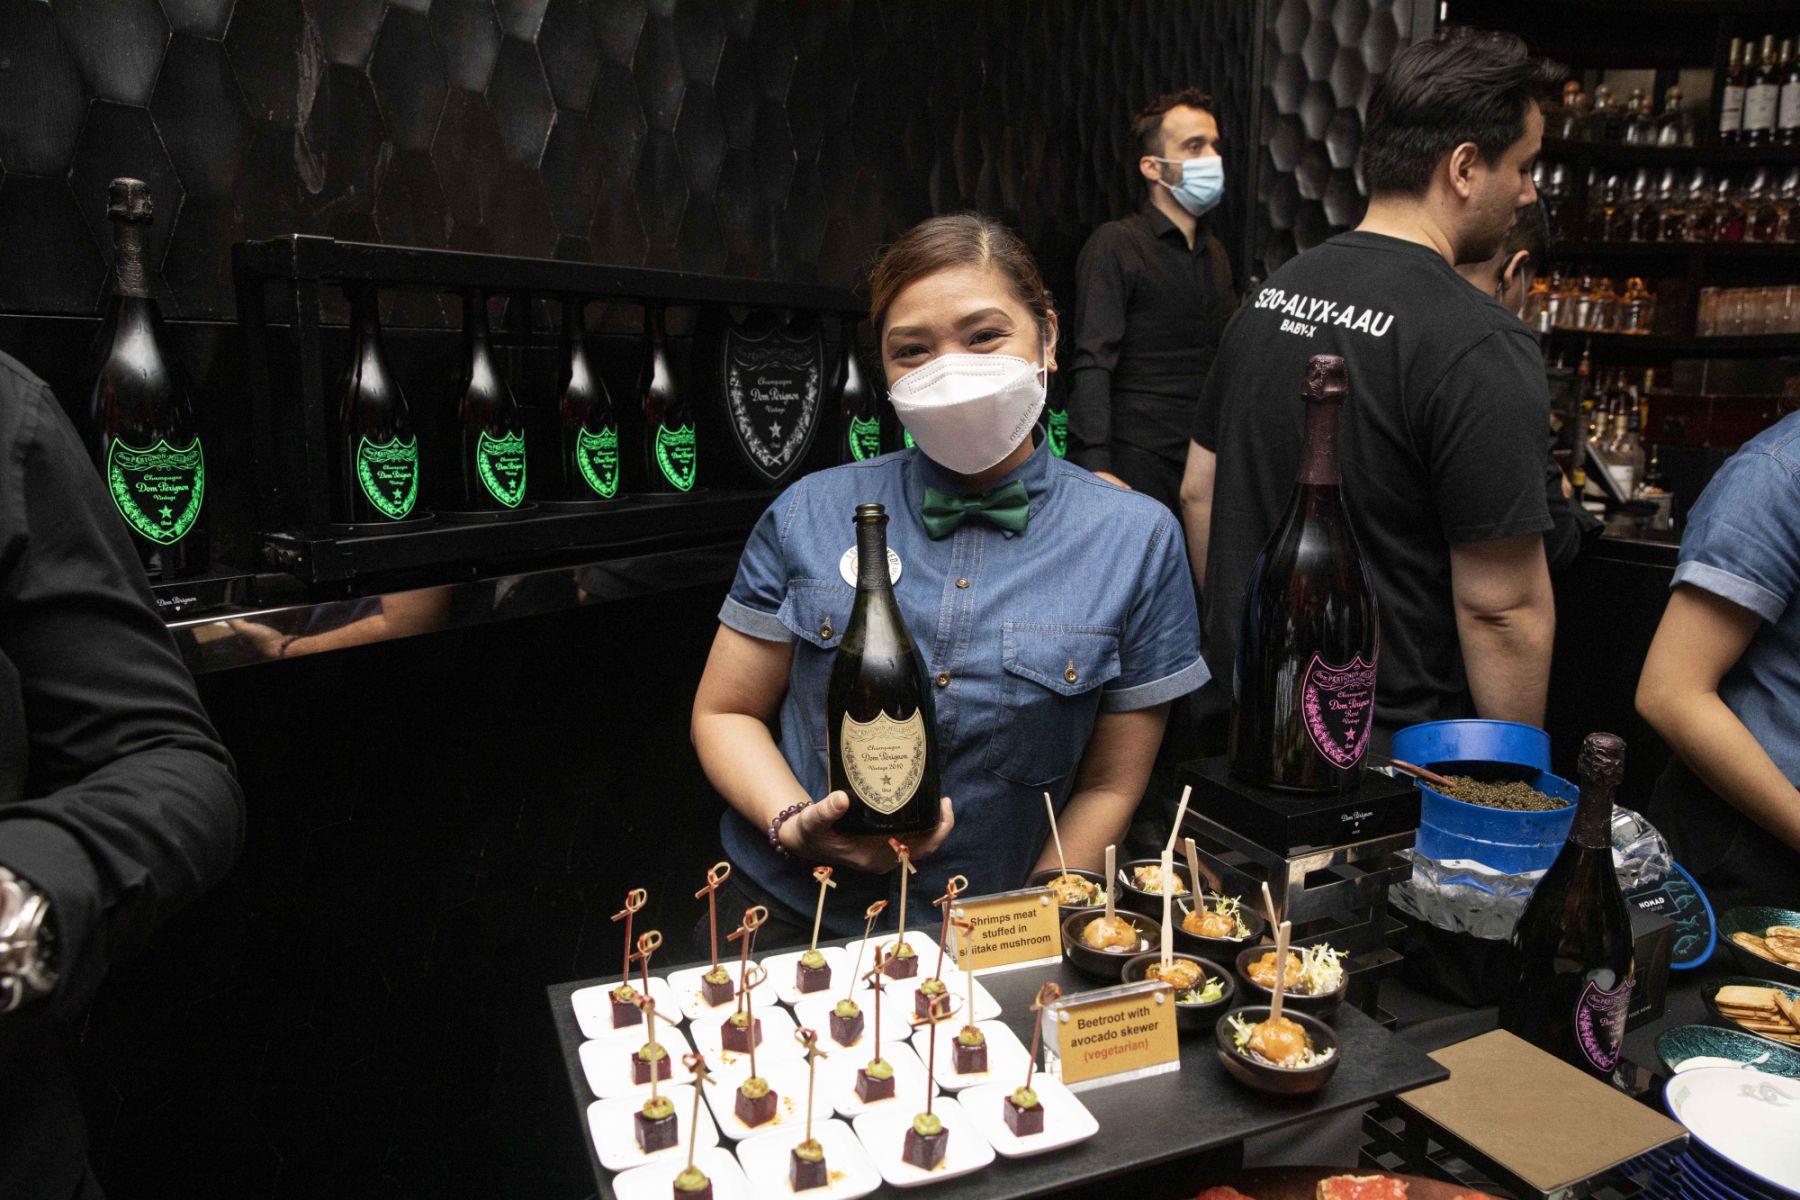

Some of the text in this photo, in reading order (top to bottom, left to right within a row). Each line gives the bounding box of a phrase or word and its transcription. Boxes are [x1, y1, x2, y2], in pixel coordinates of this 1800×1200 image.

[1280, 319, 1317, 338] BABY-X
[135, 482, 158, 493] Dom
[1329, 699, 1348, 711] Dom
[861, 752, 879, 762] Dom
[1638, 896, 1665, 909] NOMAD
[970, 909, 1037, 927] Shrimps meat
[982, 924, 1028, 939] stuffed in
[1000, 934, 1051, 949] mushroom
[1077, 1006, 1151, 1030] Beetroot with
[1071, 1021, 1159, 1048] avocado skewer
[1083, 1038, 1149, 1063] (vegetarian)
